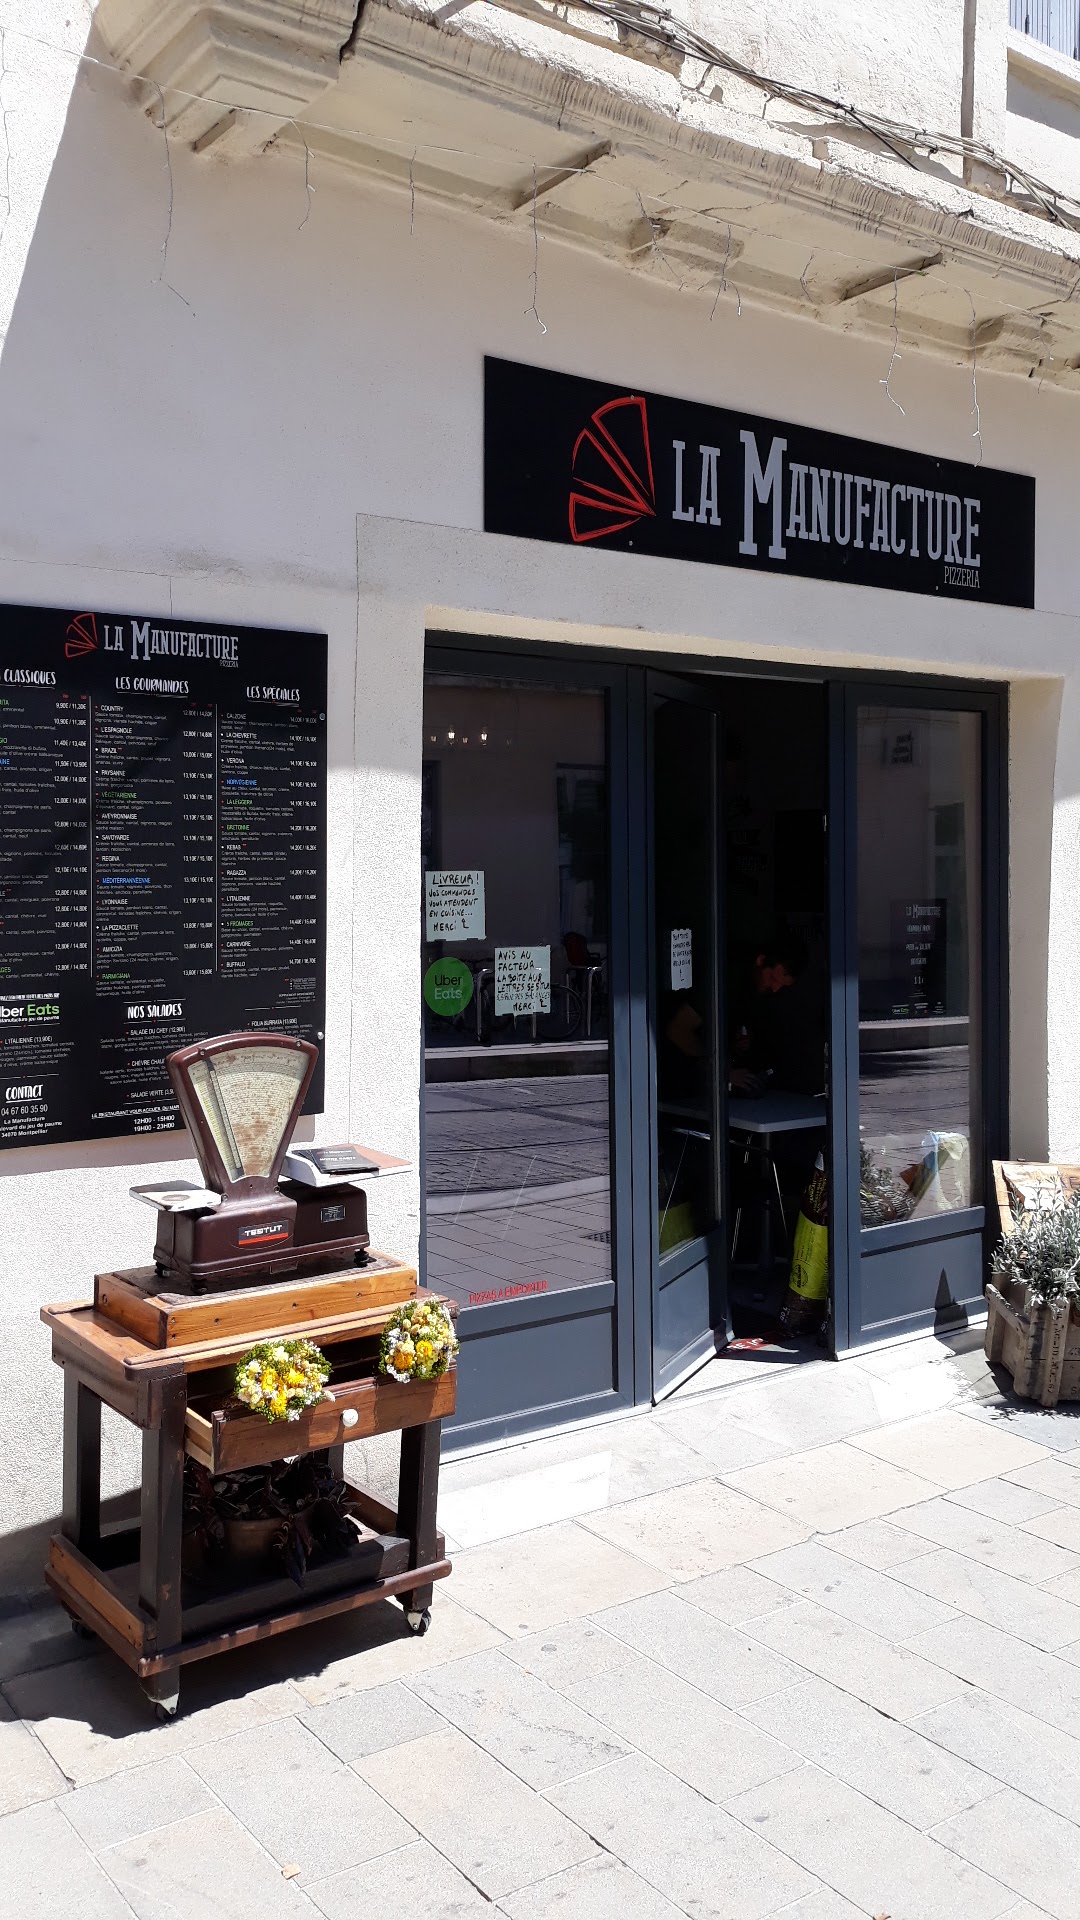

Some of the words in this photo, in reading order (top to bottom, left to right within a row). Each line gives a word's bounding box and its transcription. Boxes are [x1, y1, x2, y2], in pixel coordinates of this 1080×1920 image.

[672, 439, 721, 526] LA
[739, 429, 981, 567] MANUFACTURE
[944, 567, 980, 588] PIZZERIA
[103, 625, 124, 651] LA
[130, 620, 239, 661] MANUFACTURE
[4, 668, 56, 685] CLASSIQUES
[116, 677, 131, 690] LES
[134, 678, 189, 694] GOURMANDES
[247, 686, 260, 699] LES
[262, 686, 300, 701] SPÉCIALES
[441, 888, 476, 897] COMMANDES
[444, 898, 478, 906] ATTENDENT
[429, 910, 438, 918] EN
[520, 950, 531, 960] AU
[498, 960, 534, 972] FACTEUR
[434, 974, 462, 986] Uber
[434, 988, 462, 1000] Eats
[498, 983, 524, 993] LETTRES
[28, 1004, 60, 1016] Eats
[128, 1005, 144, 1019] NOS
[148, 1003, 182, 1018] SALADES
[6, 1084, 43, 1100] CONTACT
[1, 1108, 9, 1116] 04
[10, 1106, 19, 1115] 67
[20, 1106, 28, 1114] 60
[30, 1104, 38, 1113] 35
[40, 1104, 48, 1112] 90
[244, 1224, 282, 1237] TESTUT
[470, 1289, 497, 1304] PIZZAS
[505, 1280, 548, 1297] EMPORTER
